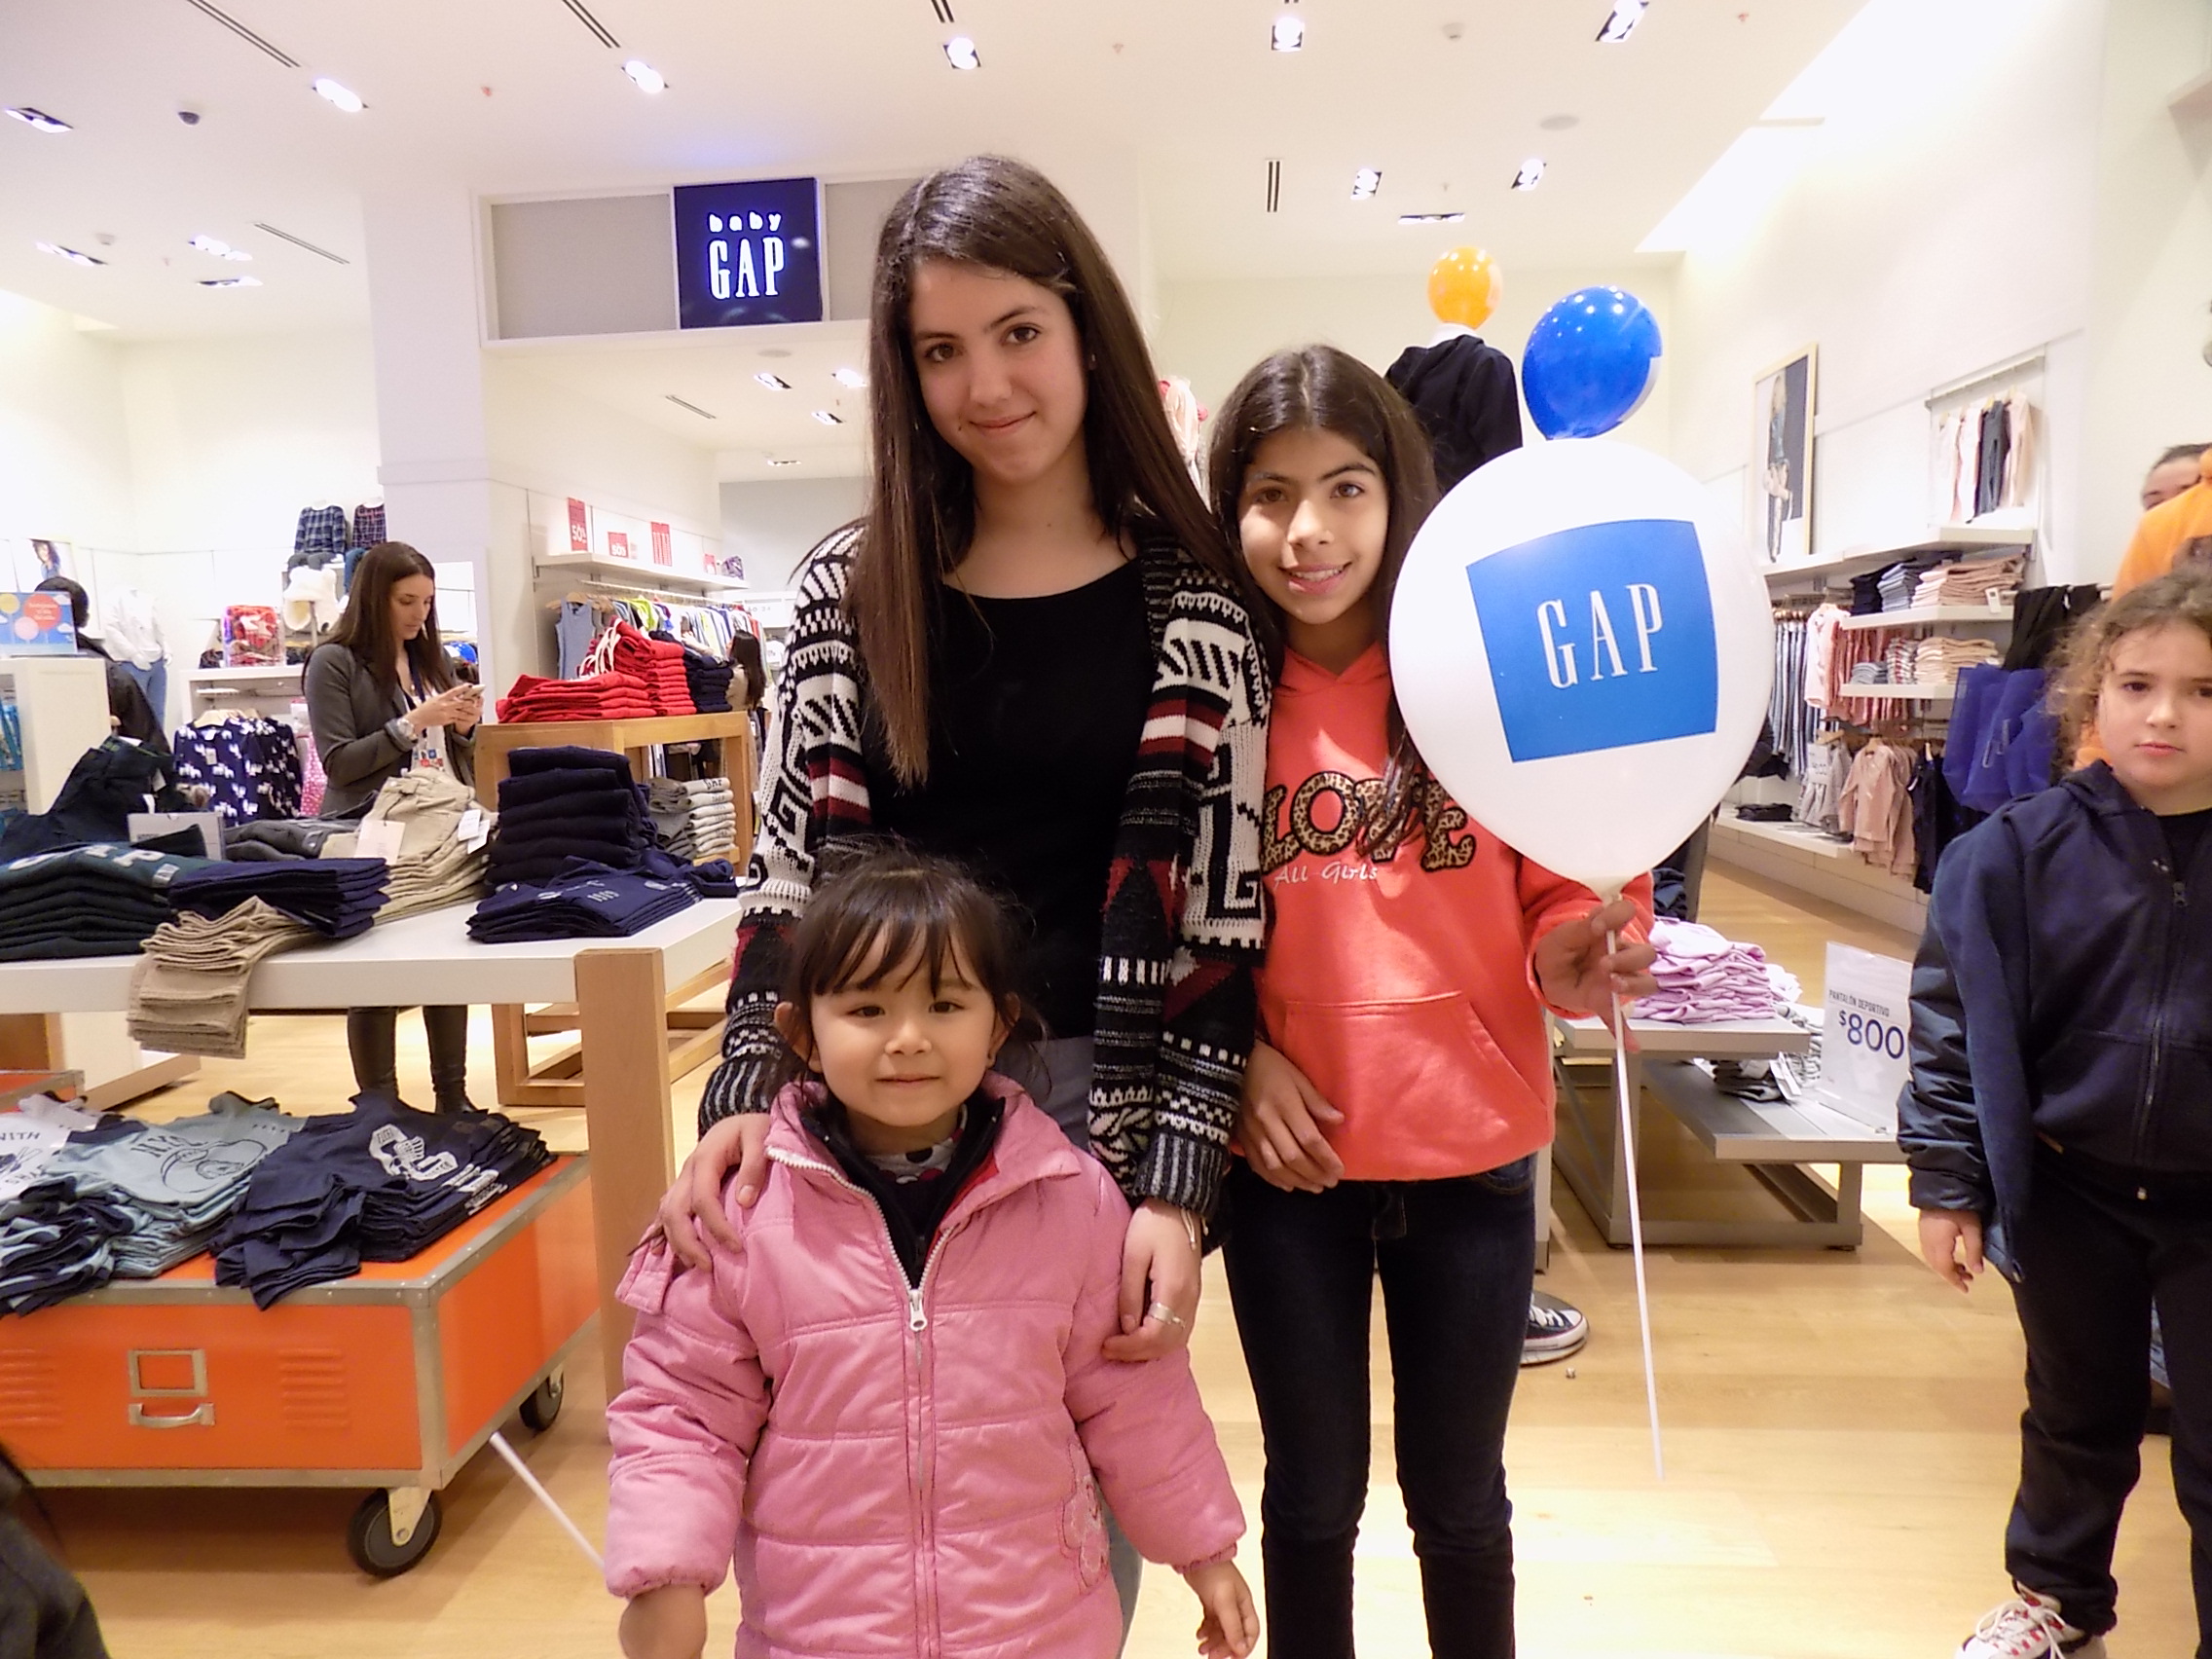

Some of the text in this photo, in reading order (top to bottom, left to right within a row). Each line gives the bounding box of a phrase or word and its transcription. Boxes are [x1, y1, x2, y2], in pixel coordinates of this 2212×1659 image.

[708, 210, 782, 233] baby
[709, 237, 785, 300] GAP
[1535, 582, 1664, 690] GAP
[1273, 861, 1379, 890] All Girls
[1858, 997, 1891, 1018] DEPORTIVO
[1838, 1009, 1905, 1060] $800
